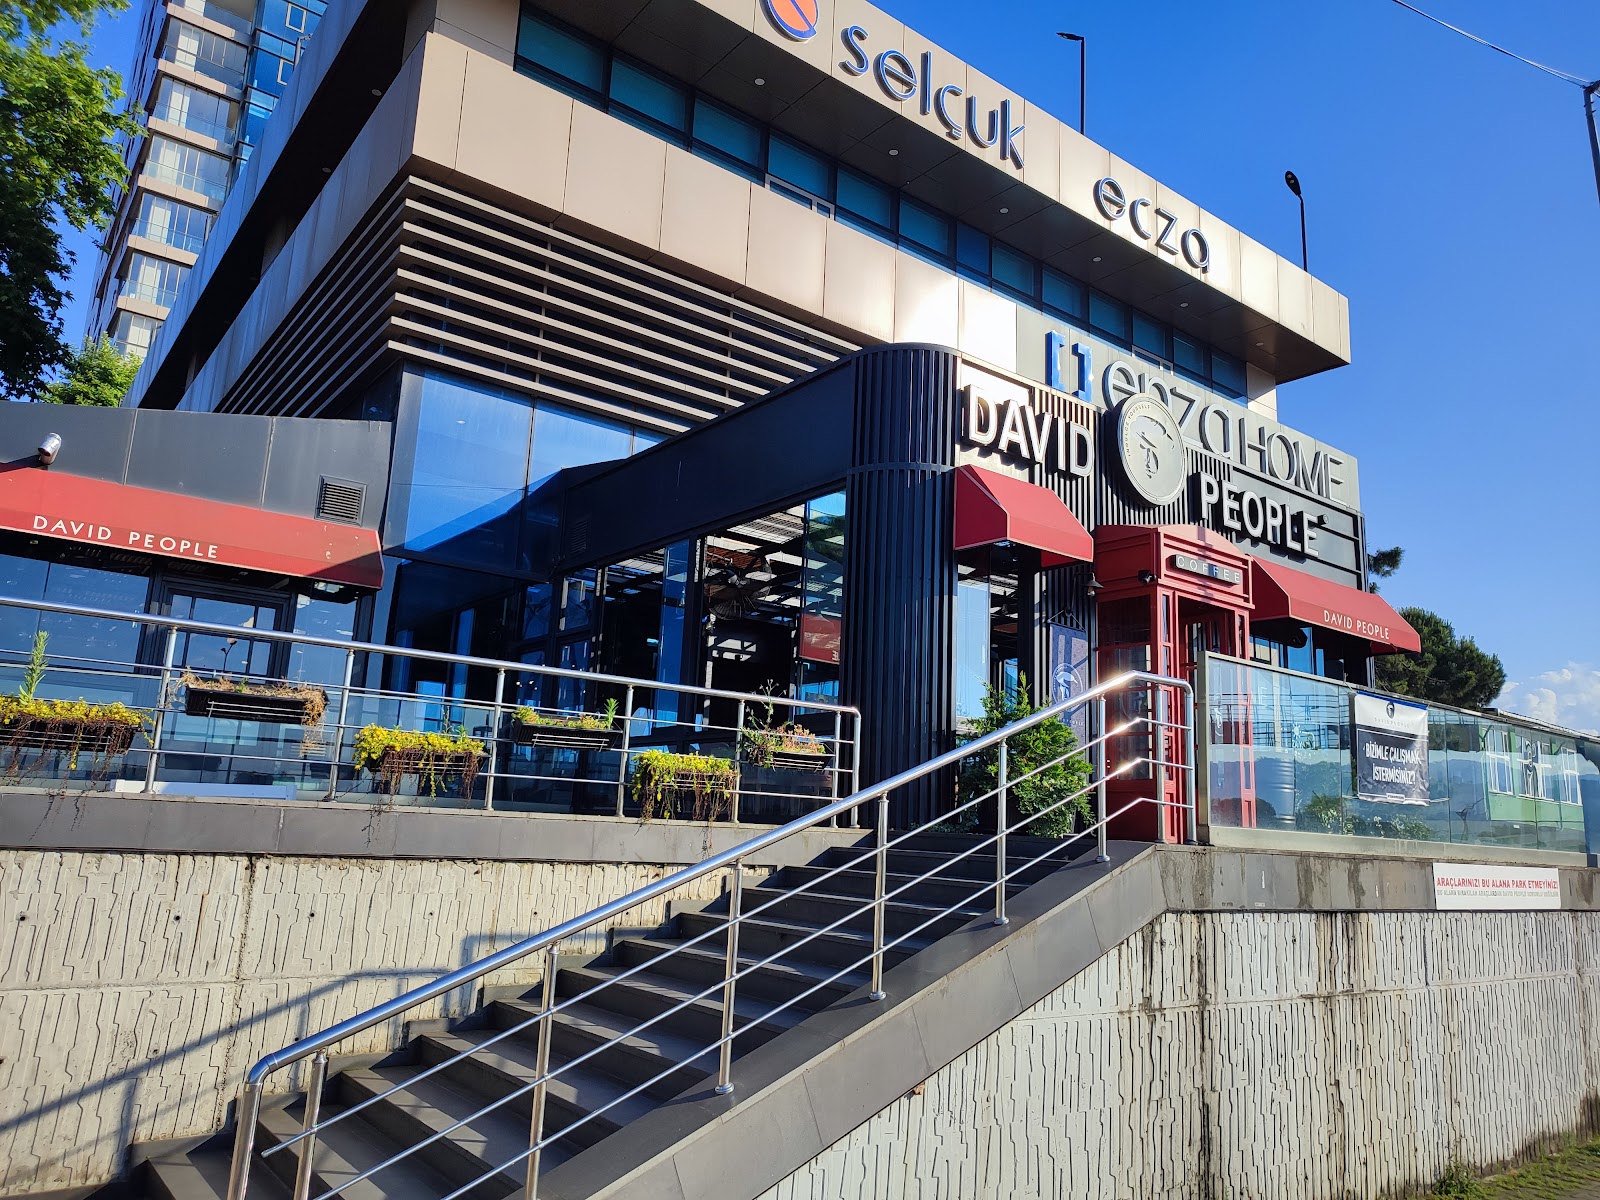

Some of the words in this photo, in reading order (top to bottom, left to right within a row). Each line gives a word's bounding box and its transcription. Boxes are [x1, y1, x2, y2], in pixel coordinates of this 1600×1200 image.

[839, 25, 1025, 170] selçuk
[1093, 176, 1210, 274] ecza
[965, 384, 1095, 477] DAVID
[1199, 471, 1320, 557] PEOPLE
[33, 515, 111, 541] DAVID
[128, 531, 218, 559] PEOPLE
[1177, 556, 1241, 583] COFFEE
[1323, 609, 1353, 630] DAVID
[1356, 619, 1390, 640] PEOPLE
[1365, 741, 1388, 760] BİZİMLE
[1389, 747, 1421, 765] ÇALIŞMAK
[1437, 877, 1480, 889] ARAÇLARINIZI
[1482, 879, 1490, 888] BU
[1491, 879, 1510, 889] ALANA
[1512, 880, 1526, 889] PARK
